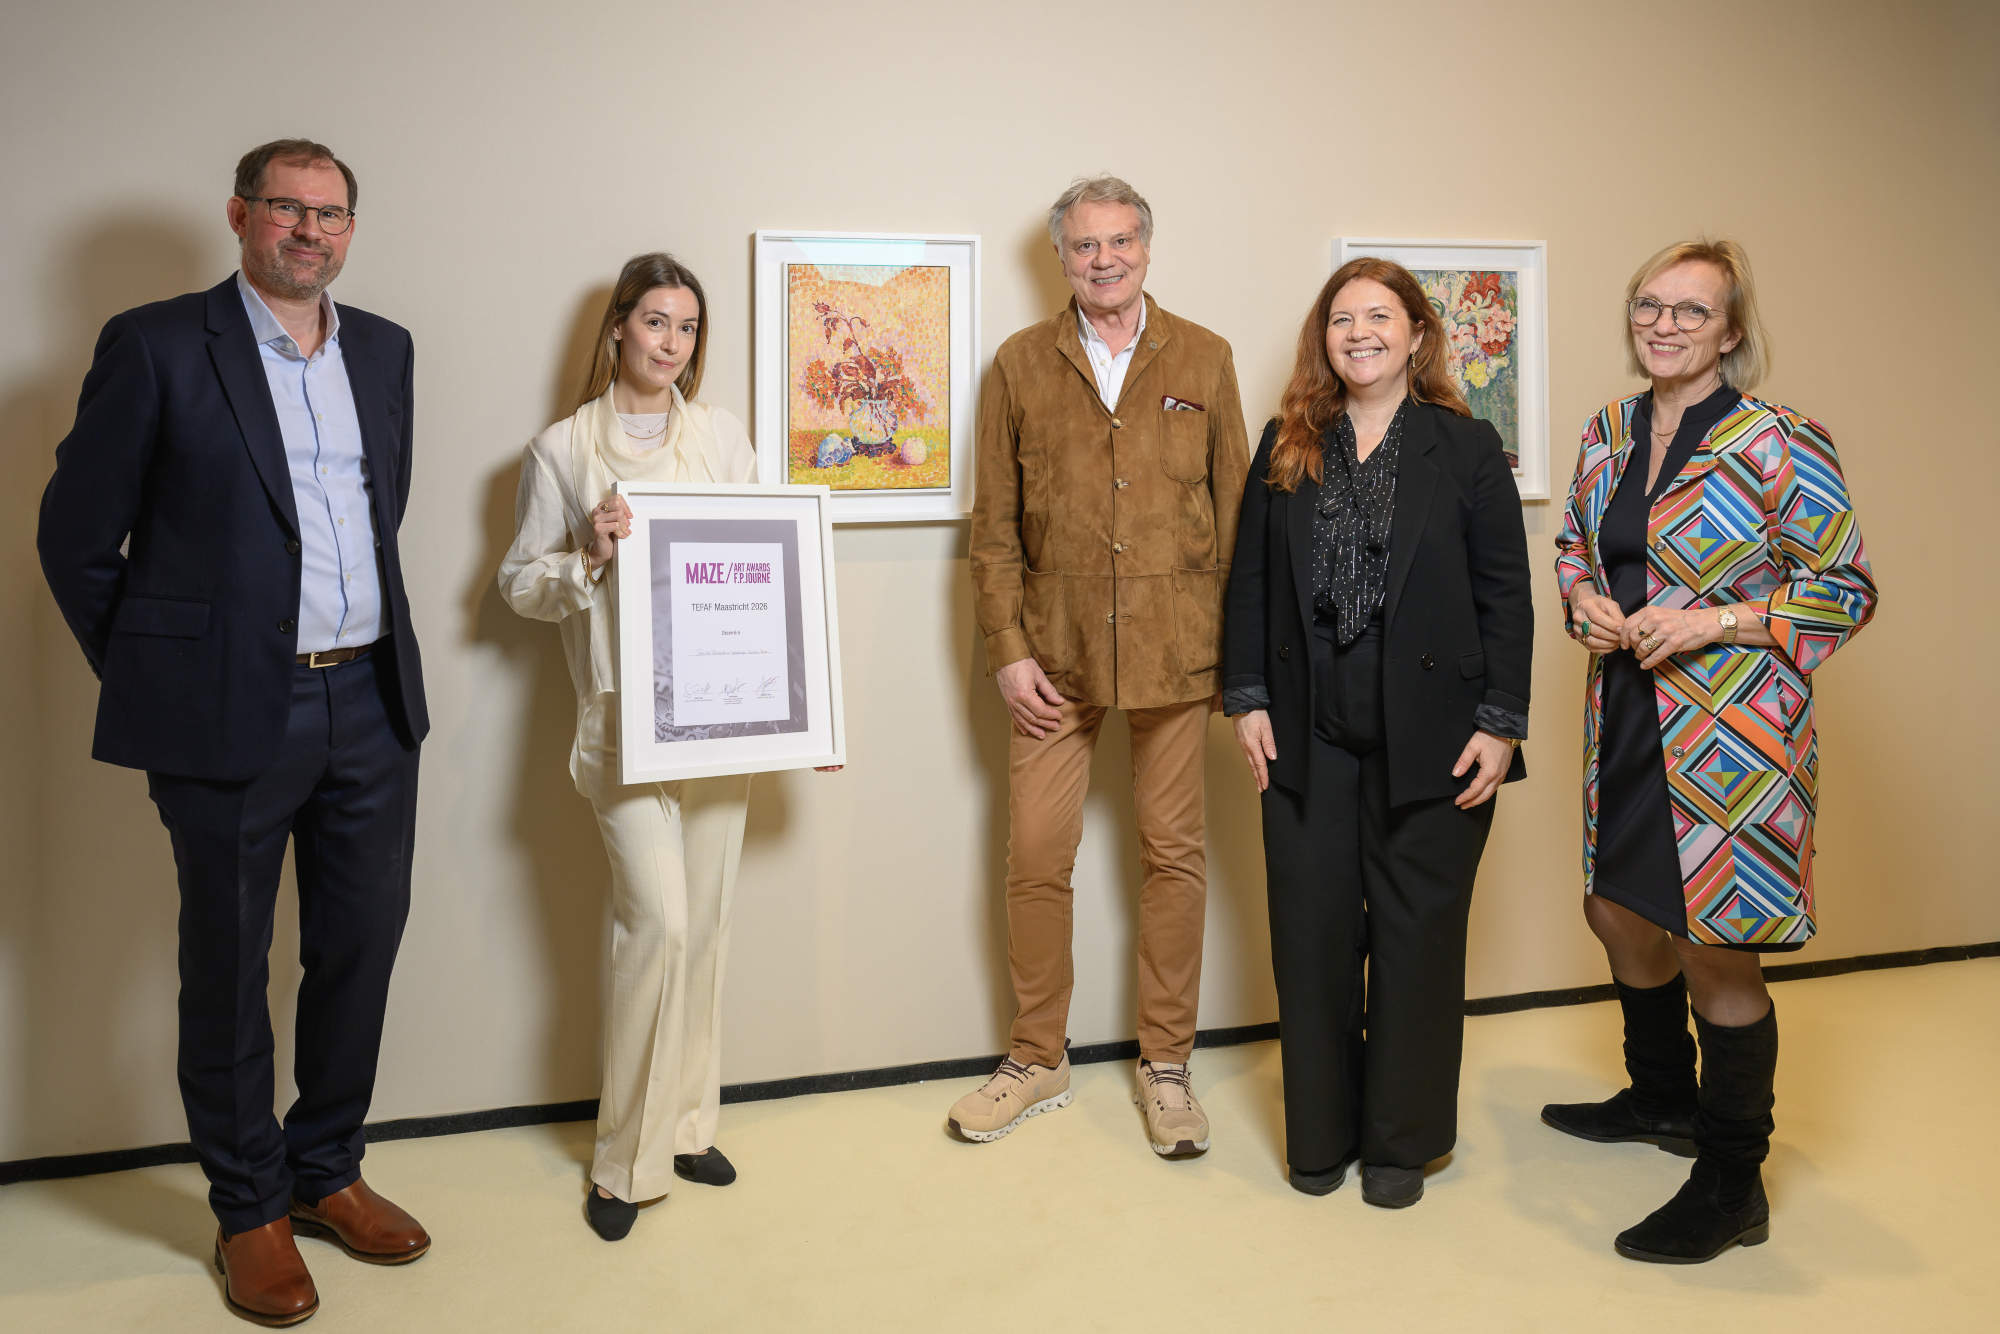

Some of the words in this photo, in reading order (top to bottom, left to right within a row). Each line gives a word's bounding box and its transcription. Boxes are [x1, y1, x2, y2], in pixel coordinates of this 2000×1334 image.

[734, 562, 745, 572] ART
[746, 562, 771, 572] AWARDS
[691, 603, 713, 612] TEFAF
[714, 602, 750, 611] Maastricht
[751, 602, 768, 611] 2026
